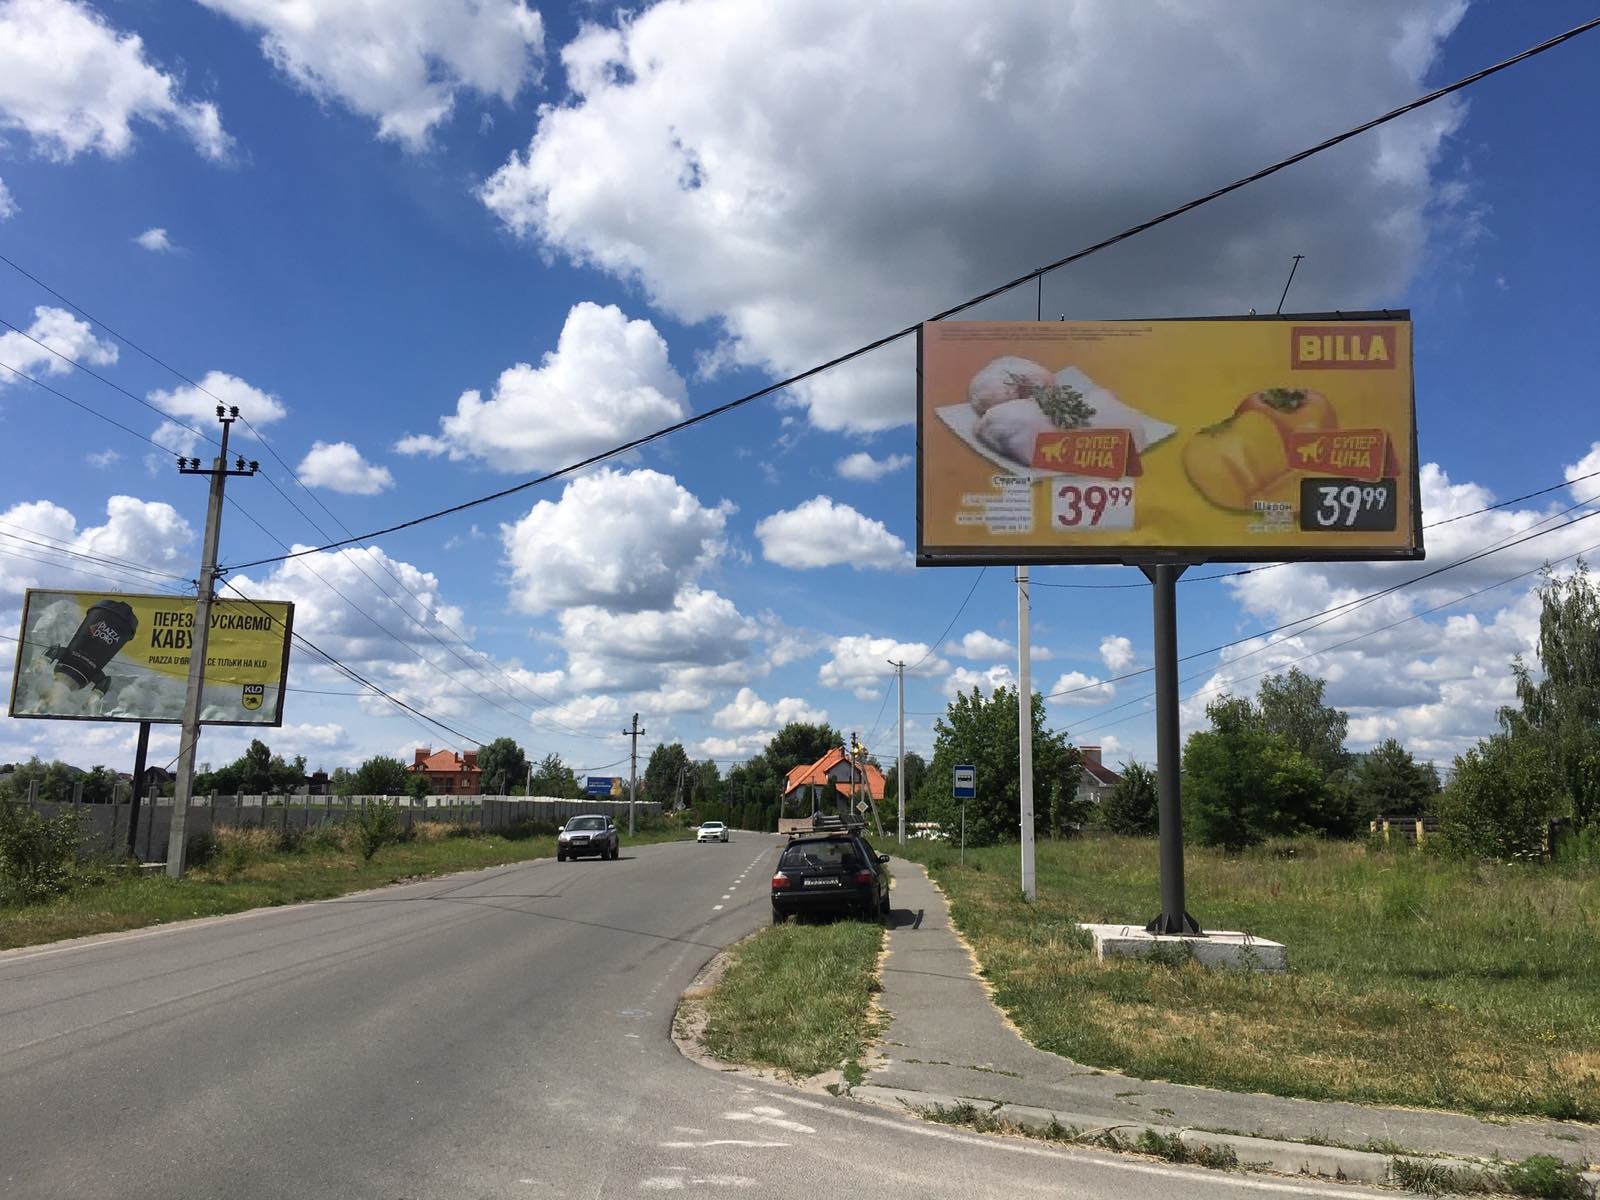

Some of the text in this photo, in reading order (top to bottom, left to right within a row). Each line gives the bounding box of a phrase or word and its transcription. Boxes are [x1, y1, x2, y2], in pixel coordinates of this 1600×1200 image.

[1299, 335, 1389, 361] BILLA
[1073, 450, 1114, 468] ЦІНА
[1330, 450, 1371, 468] ЦІНА
[148, 655, 172, 665] PIAZZA
[173, 655, 191, 665] D'OR
